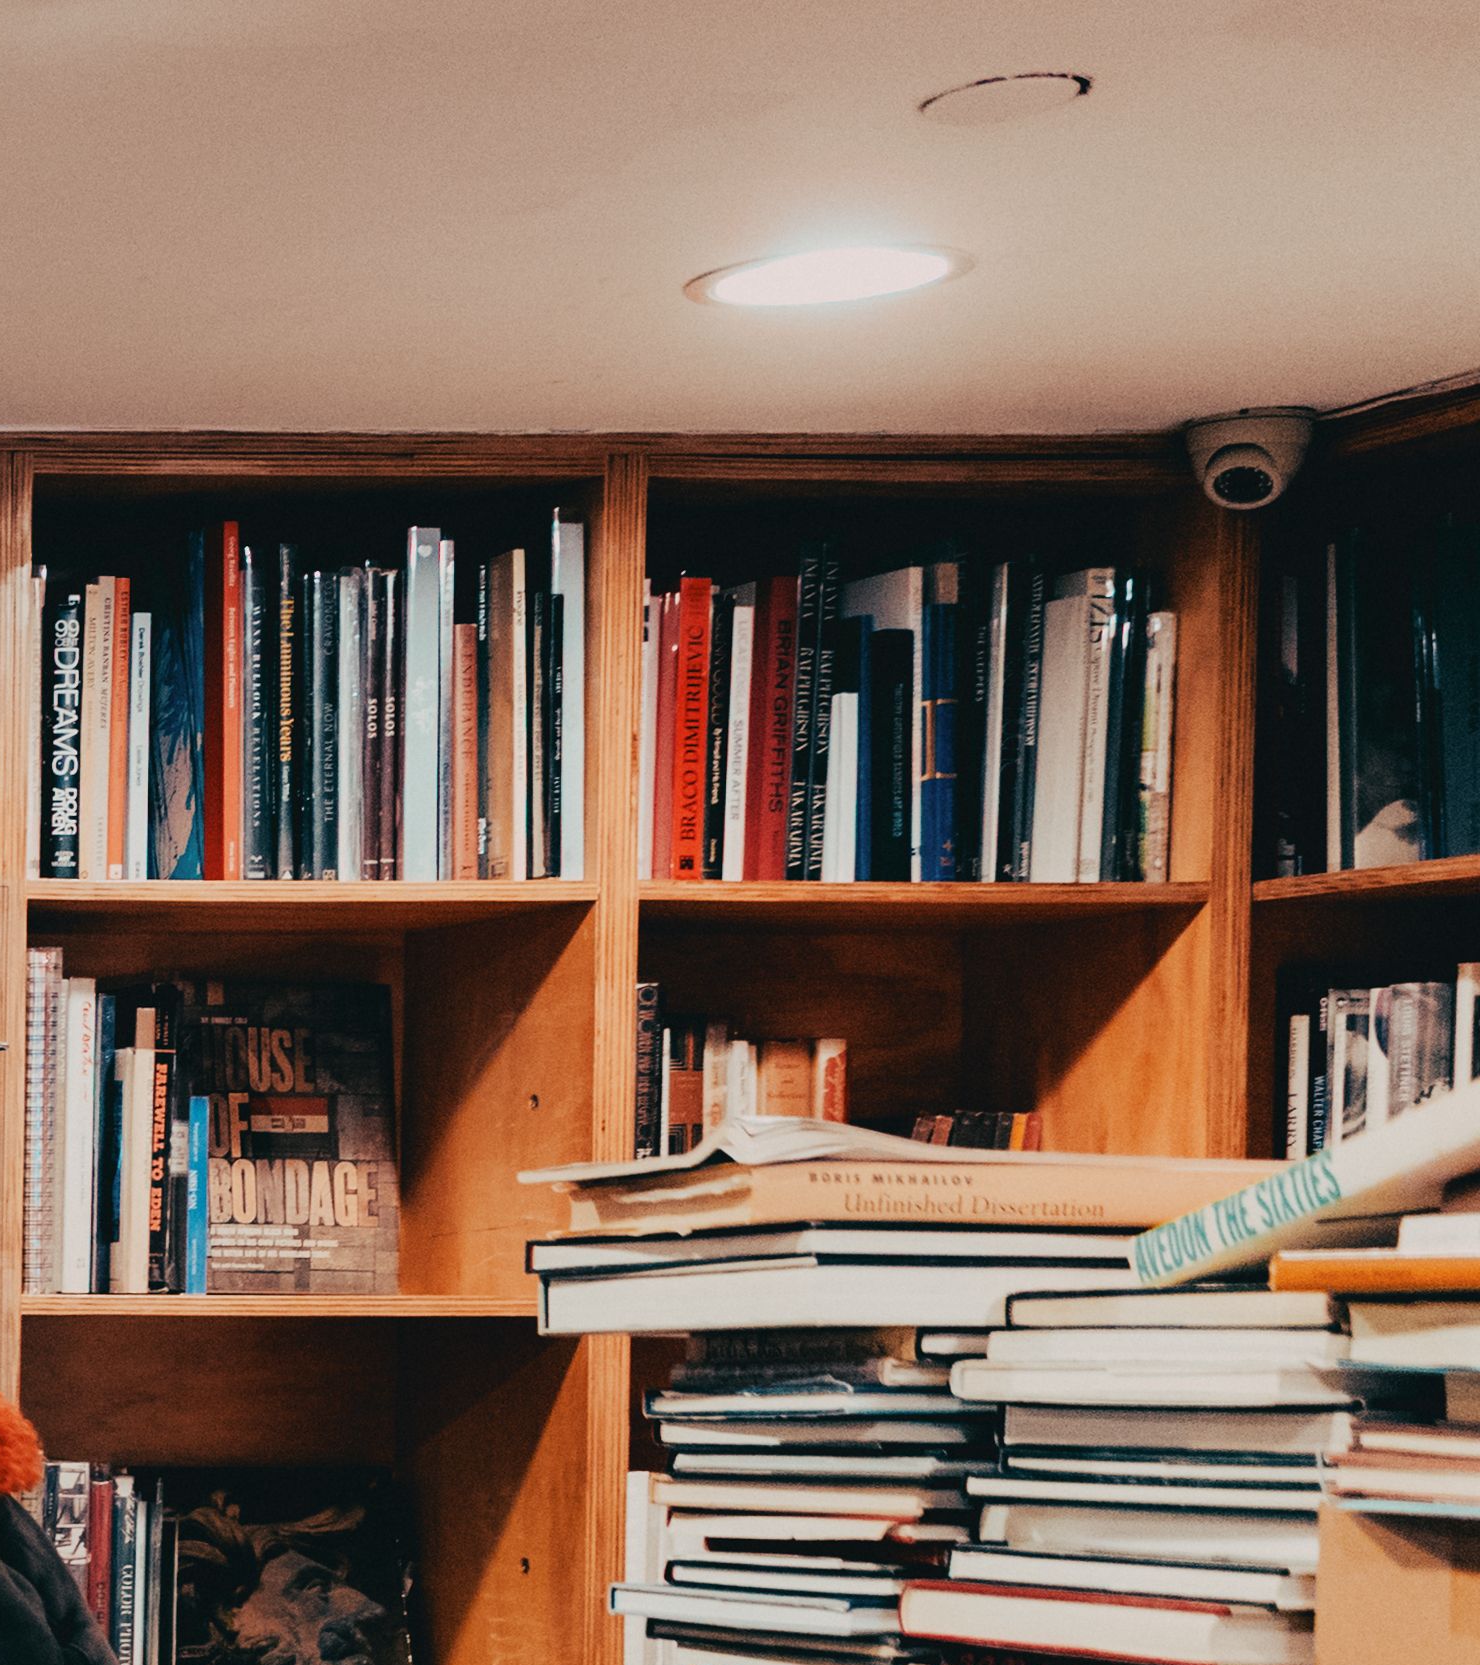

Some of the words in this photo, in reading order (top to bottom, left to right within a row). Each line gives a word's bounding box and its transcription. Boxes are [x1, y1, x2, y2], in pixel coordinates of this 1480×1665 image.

[280, 597, 295, 631] The
[279, 634, 295, 716] Luminous
[775, 620, 793, 690] BRIAN
[51, 647, 79, 775] DREAMS
[367, 698, 377, 739] SOLOS
[384, 696, 395, 737] SOLOS
[279, 718, 294, 762] Years
[731, 719, 743, 768] SUMMER
[769, 697, 789, 813] GRIFFITHS
[64, 787, 78, 835] DOUG
[679, 772, 696, 841] BRACO
[730, 774, 740, 820] AFTER
[213, 1027, 316, 1093] HOUSE
[154, 1064, 167, 1153] FAREWELL
[153, 1158, 164, 1181] TO
[209, 1158, 380, 1227] BONDAGE
[810, 1171, 862, 1184] BORIS
[872, 1173, 974, 1186] MIKHAILOV
[150, 1187, 162, 1231] EDEN
[843, 1191, 965, 1216] Unfinished
[971, 1194, 1106, 1219] Dissertation
[1133, 1210, 1210, 1286] AVEDON
[1212, 1195, 1256, 1250] THE
[1254, 1154, 1344, 1233] SIXTIES
[120, 1565, 133, 1614] COLOR
